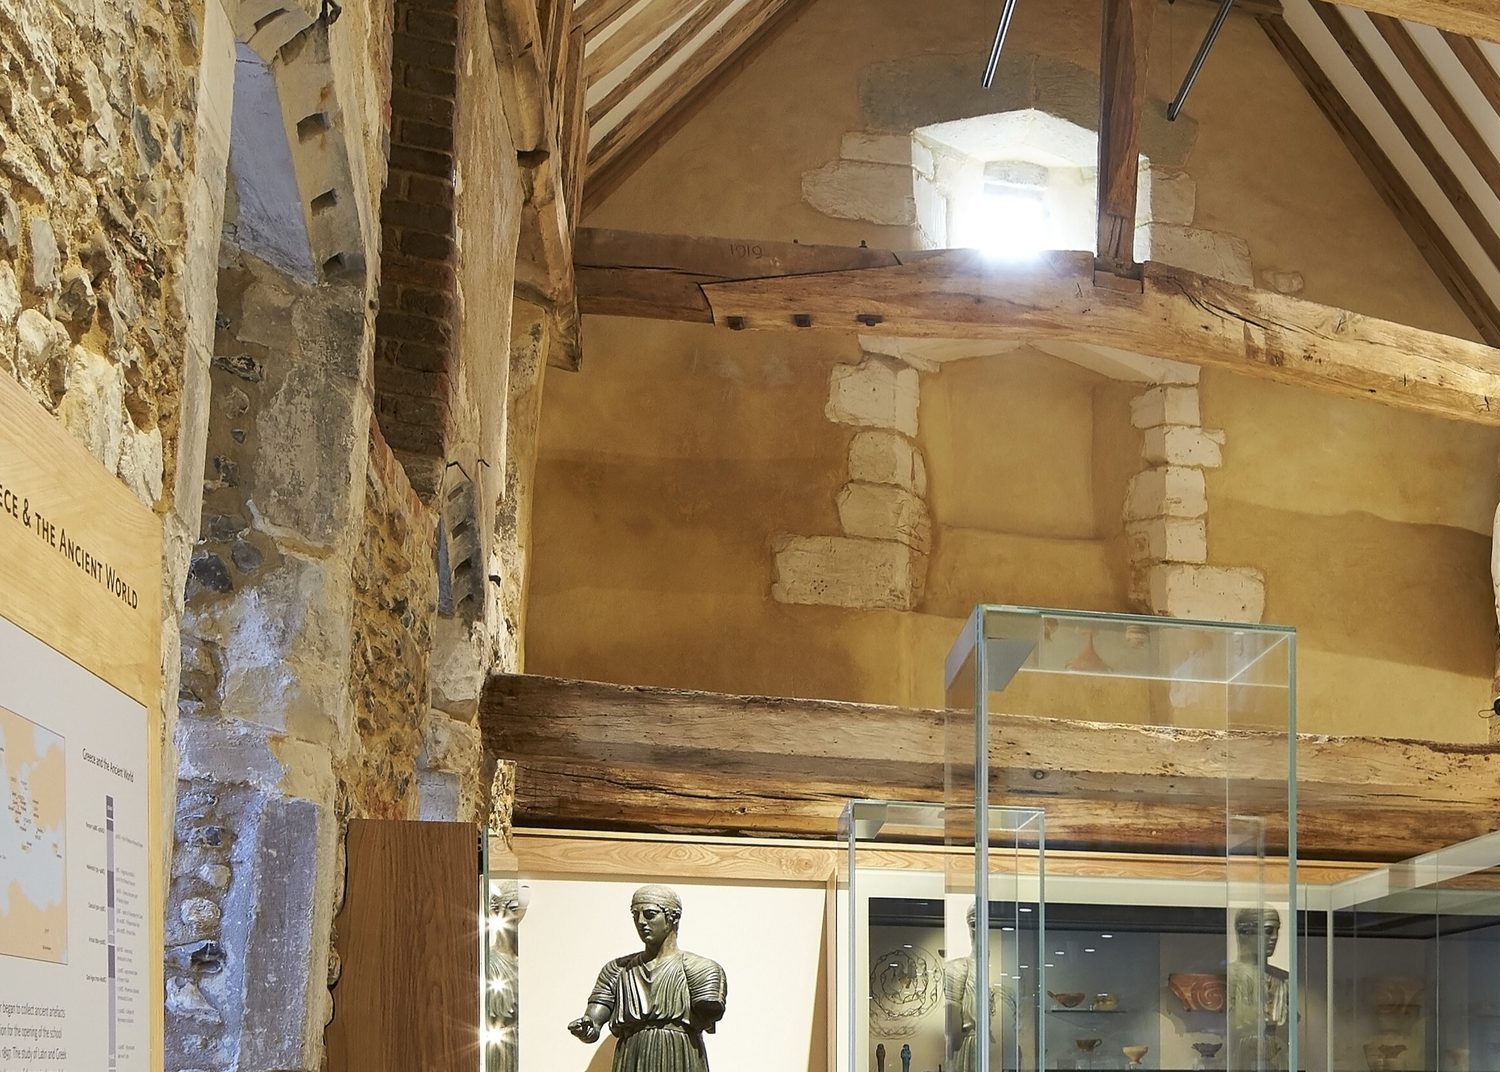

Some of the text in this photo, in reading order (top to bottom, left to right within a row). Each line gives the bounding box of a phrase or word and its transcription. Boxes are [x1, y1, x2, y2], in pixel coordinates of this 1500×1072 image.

[22, 498, 31, 528] &
[35, 512, 55, 548] THE
[59, 528, 102, 583] ANCIENT
[105, 563, 138, 609] WORLD
[82, 748, 95, 764] Greece
[110, 762, 123, 778] Ancient
[124, 768, 134, 783] World
